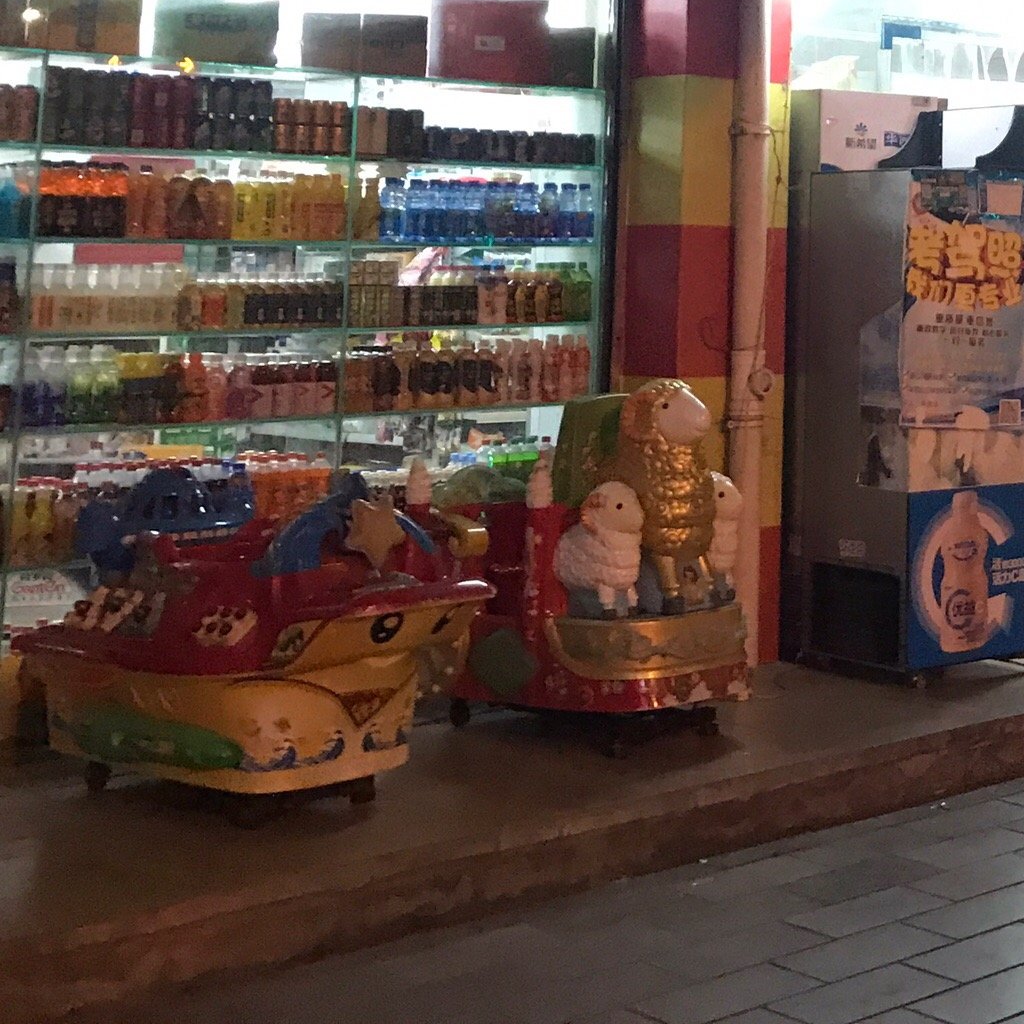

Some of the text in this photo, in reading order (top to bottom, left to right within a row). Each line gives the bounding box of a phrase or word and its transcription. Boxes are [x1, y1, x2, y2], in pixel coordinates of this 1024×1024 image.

[907, 219, 1023, 280] 考驾照
[906, 266, 1024, 312] 我们更专业
